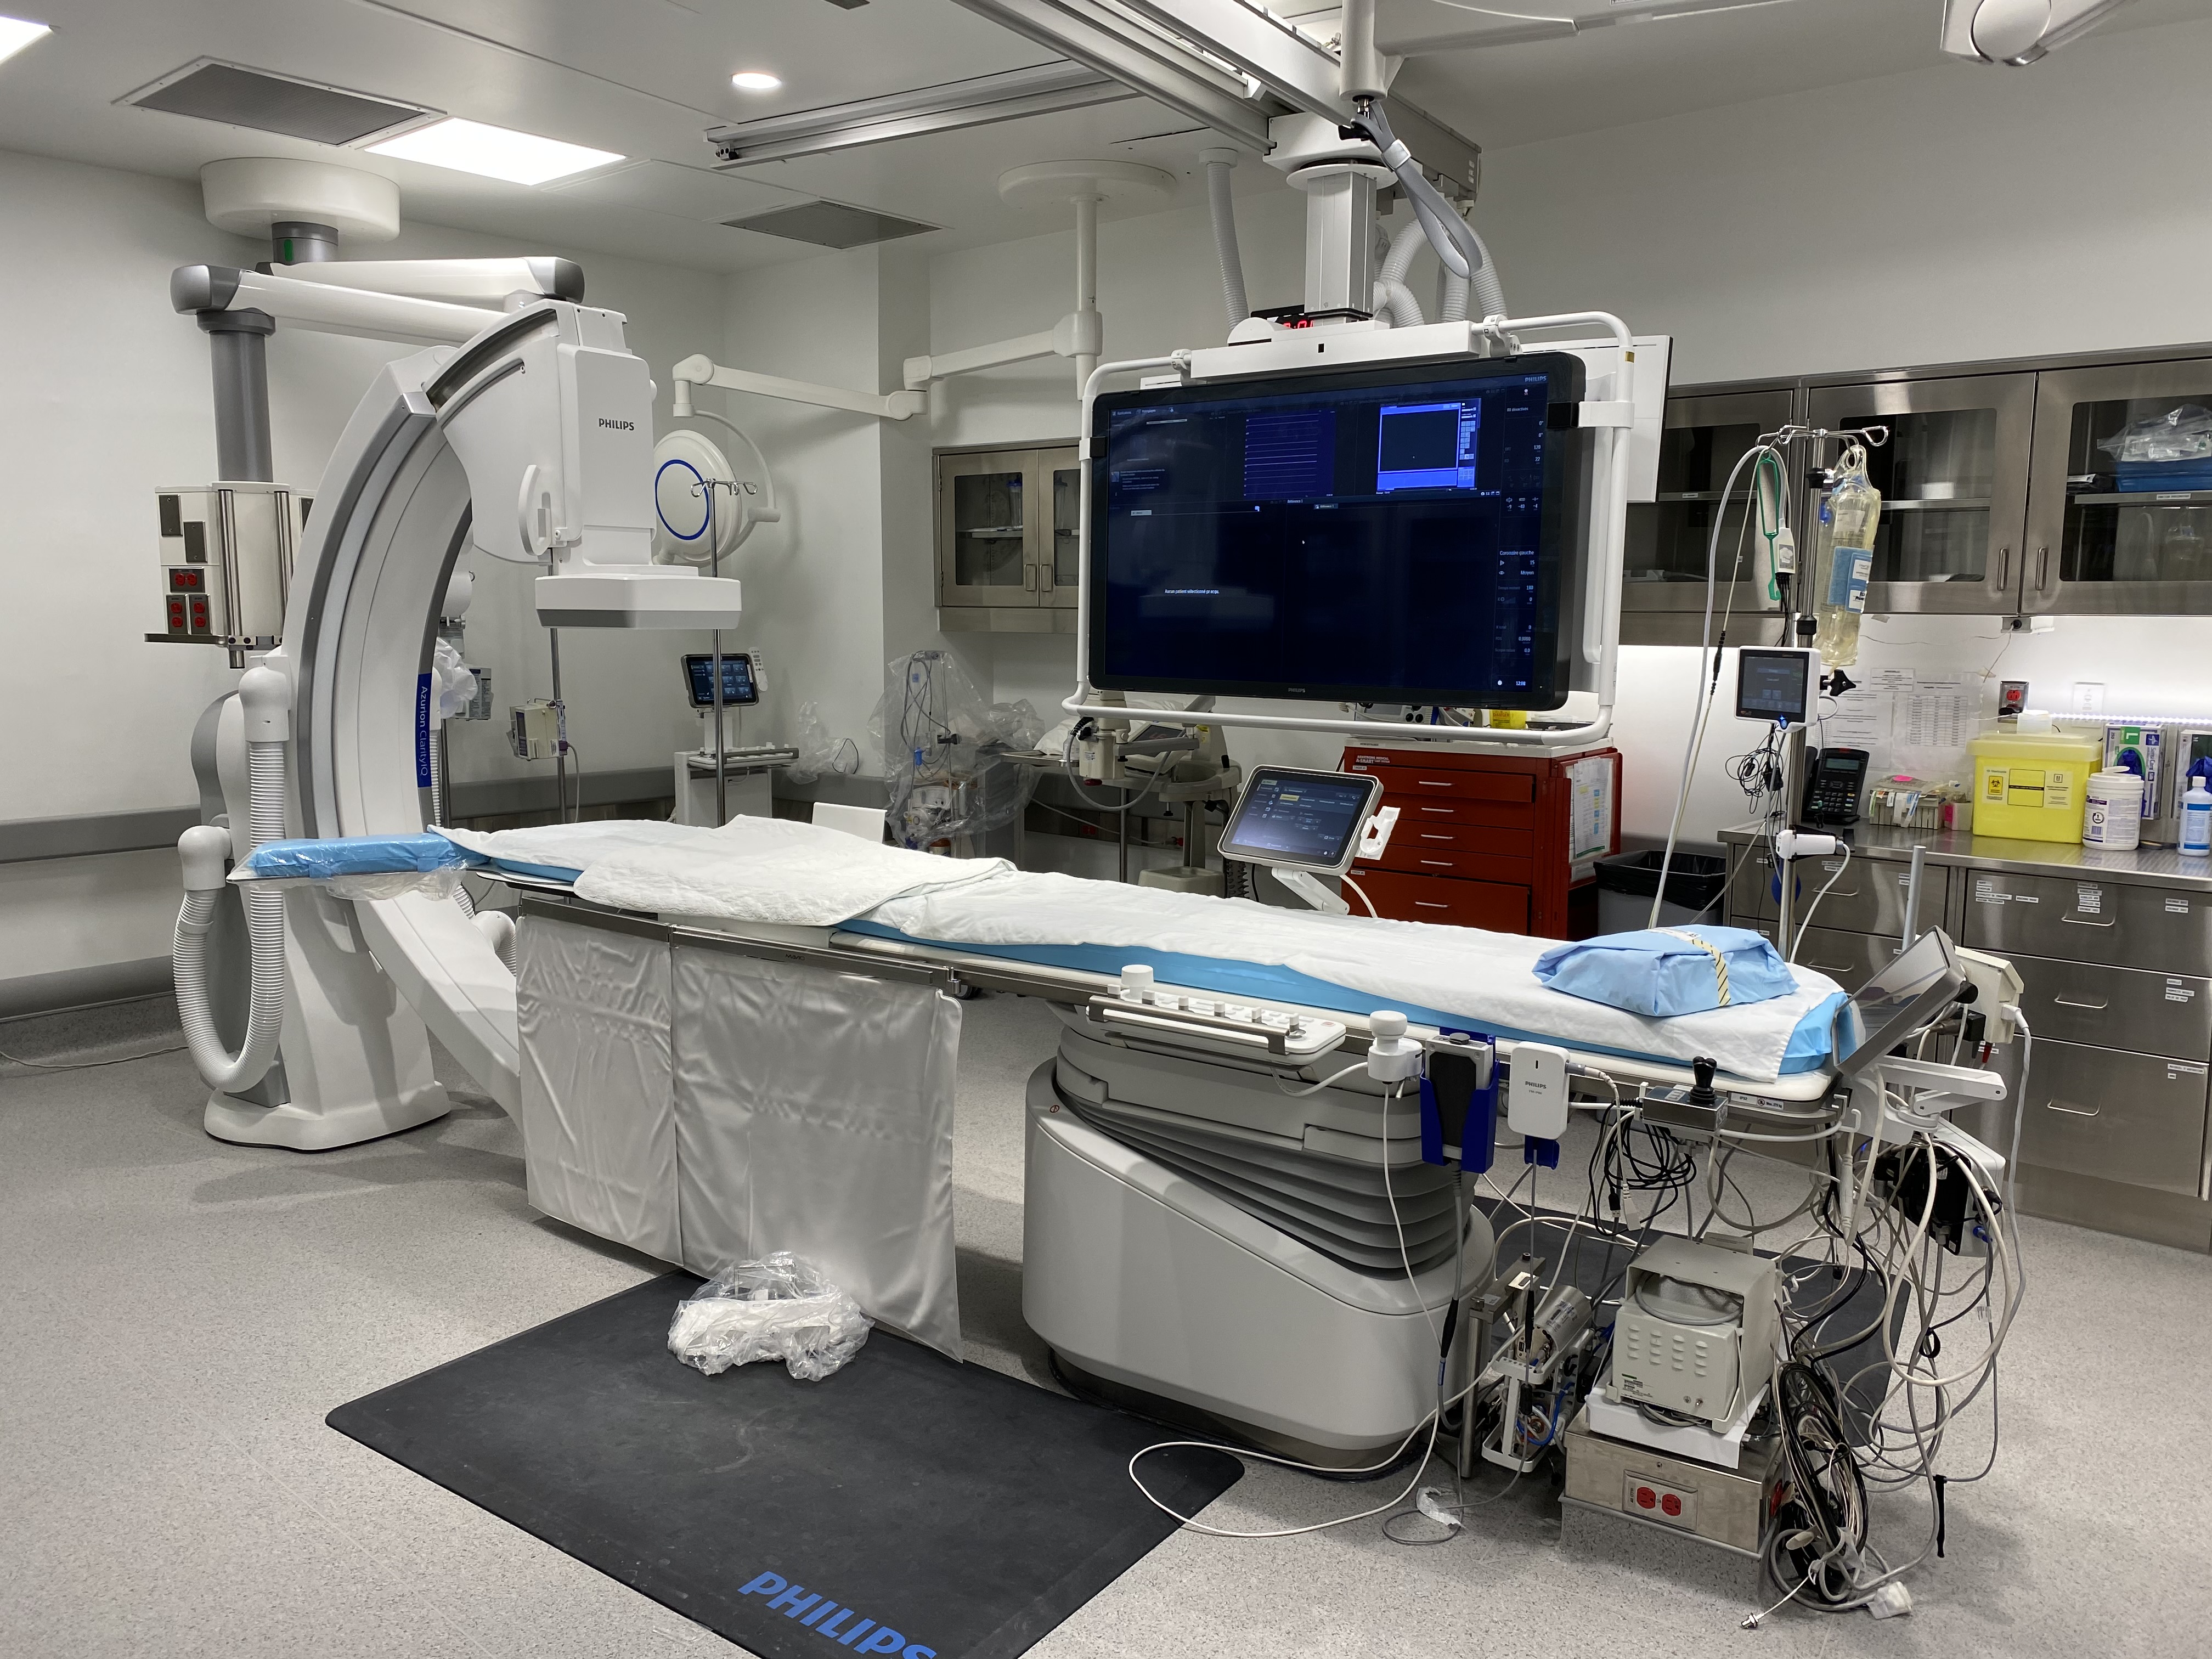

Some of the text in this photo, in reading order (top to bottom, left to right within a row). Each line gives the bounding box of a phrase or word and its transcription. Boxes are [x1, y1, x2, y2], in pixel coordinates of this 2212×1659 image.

[599, 417, 635, 431] PHILIPS
[419, 686, 428, 776] Azurion ClarityIQ
[1525, 1081, 1547, 1089] PHILIPS
